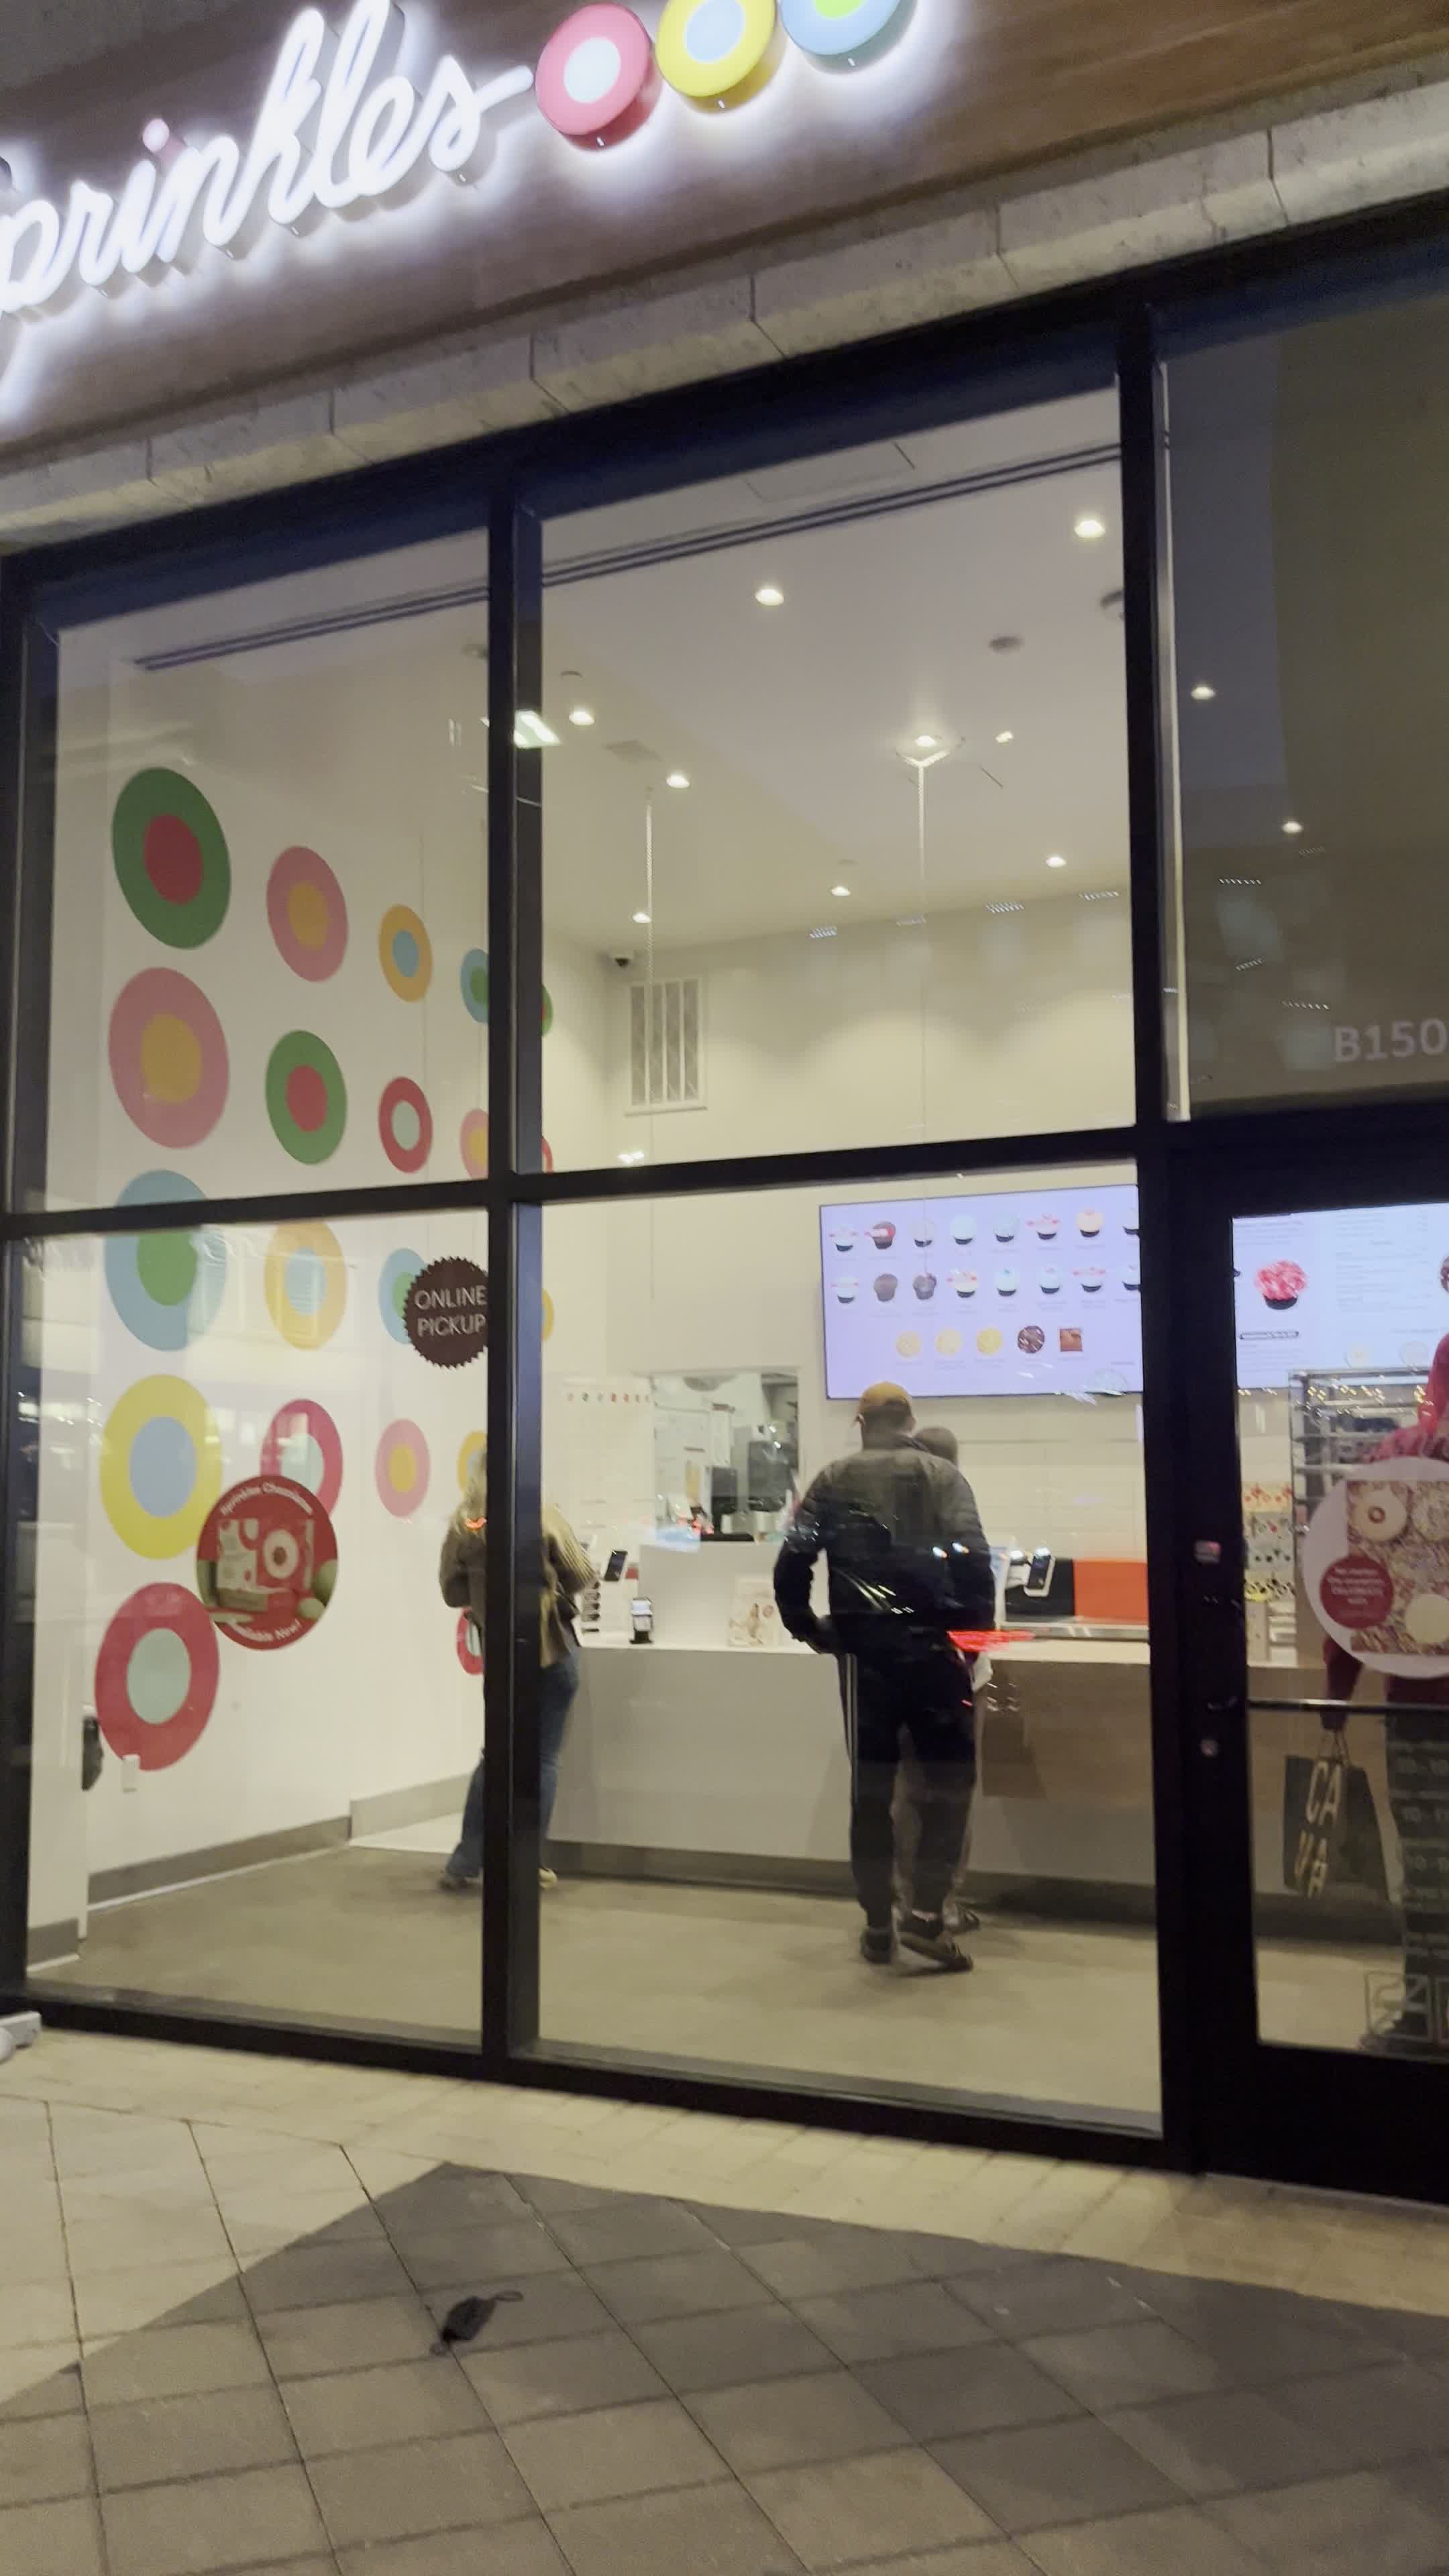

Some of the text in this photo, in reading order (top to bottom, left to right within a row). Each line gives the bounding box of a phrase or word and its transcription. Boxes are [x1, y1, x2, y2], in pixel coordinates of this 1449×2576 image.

[0, 0, 534, 314] prinkles
[1333, 1018, 1448, 1063] B150
[414, 1285, 488, 1310] ONLINE
[417, 1313, 486, 1337] PICKUP
